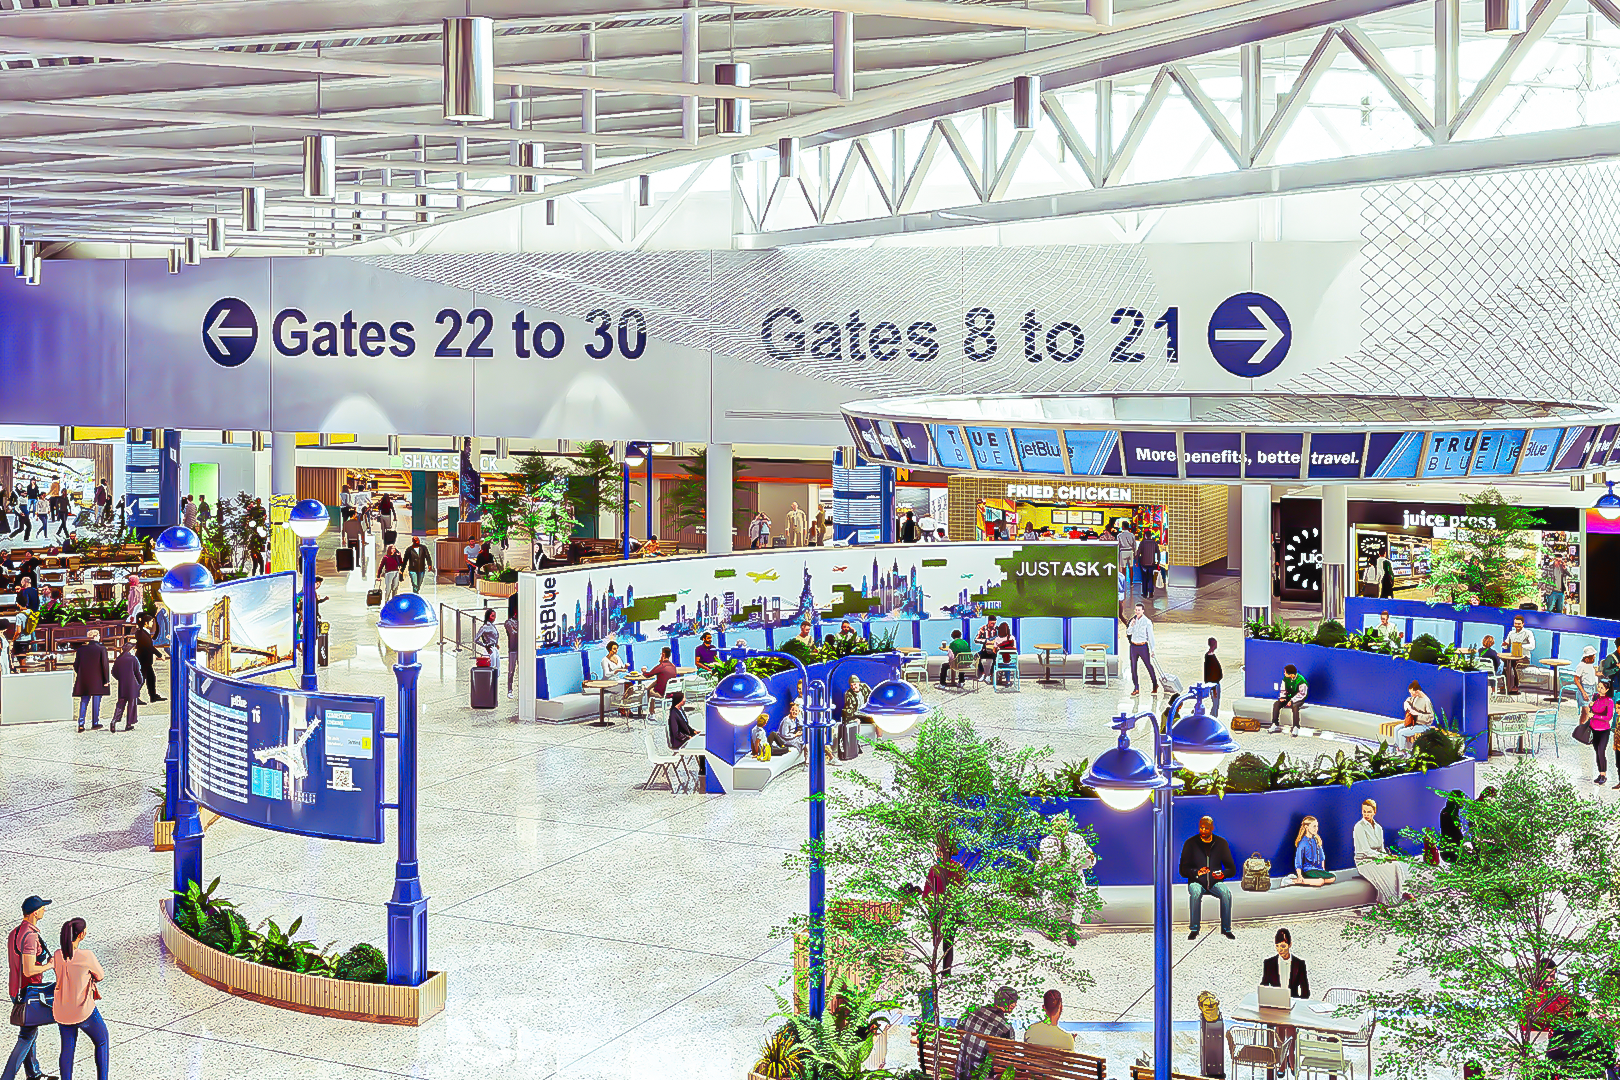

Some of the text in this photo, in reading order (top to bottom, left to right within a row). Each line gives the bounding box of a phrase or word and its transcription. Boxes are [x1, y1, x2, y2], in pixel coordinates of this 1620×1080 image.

[272, 308, 648, 360] Gates 22 to 30
[761, 306, 1180, 364] Gates 8 to 21
[1434, 436, 1492, 453] TRUE
[403, 454, 498, 472] SHAKE SCK
[1135, 447, 1177, 462] More
[1257, 450, 1301, 464] bette
[1310, 451, 1360, 465] travel.
[1428, 456, 1486, 470] BLUE
[1007, 483, 1132, 501] FRIED CHICKEN
[1403, 509, 1497, 530] juice press
[1016, 561, 1100, 577] JUST ASK
